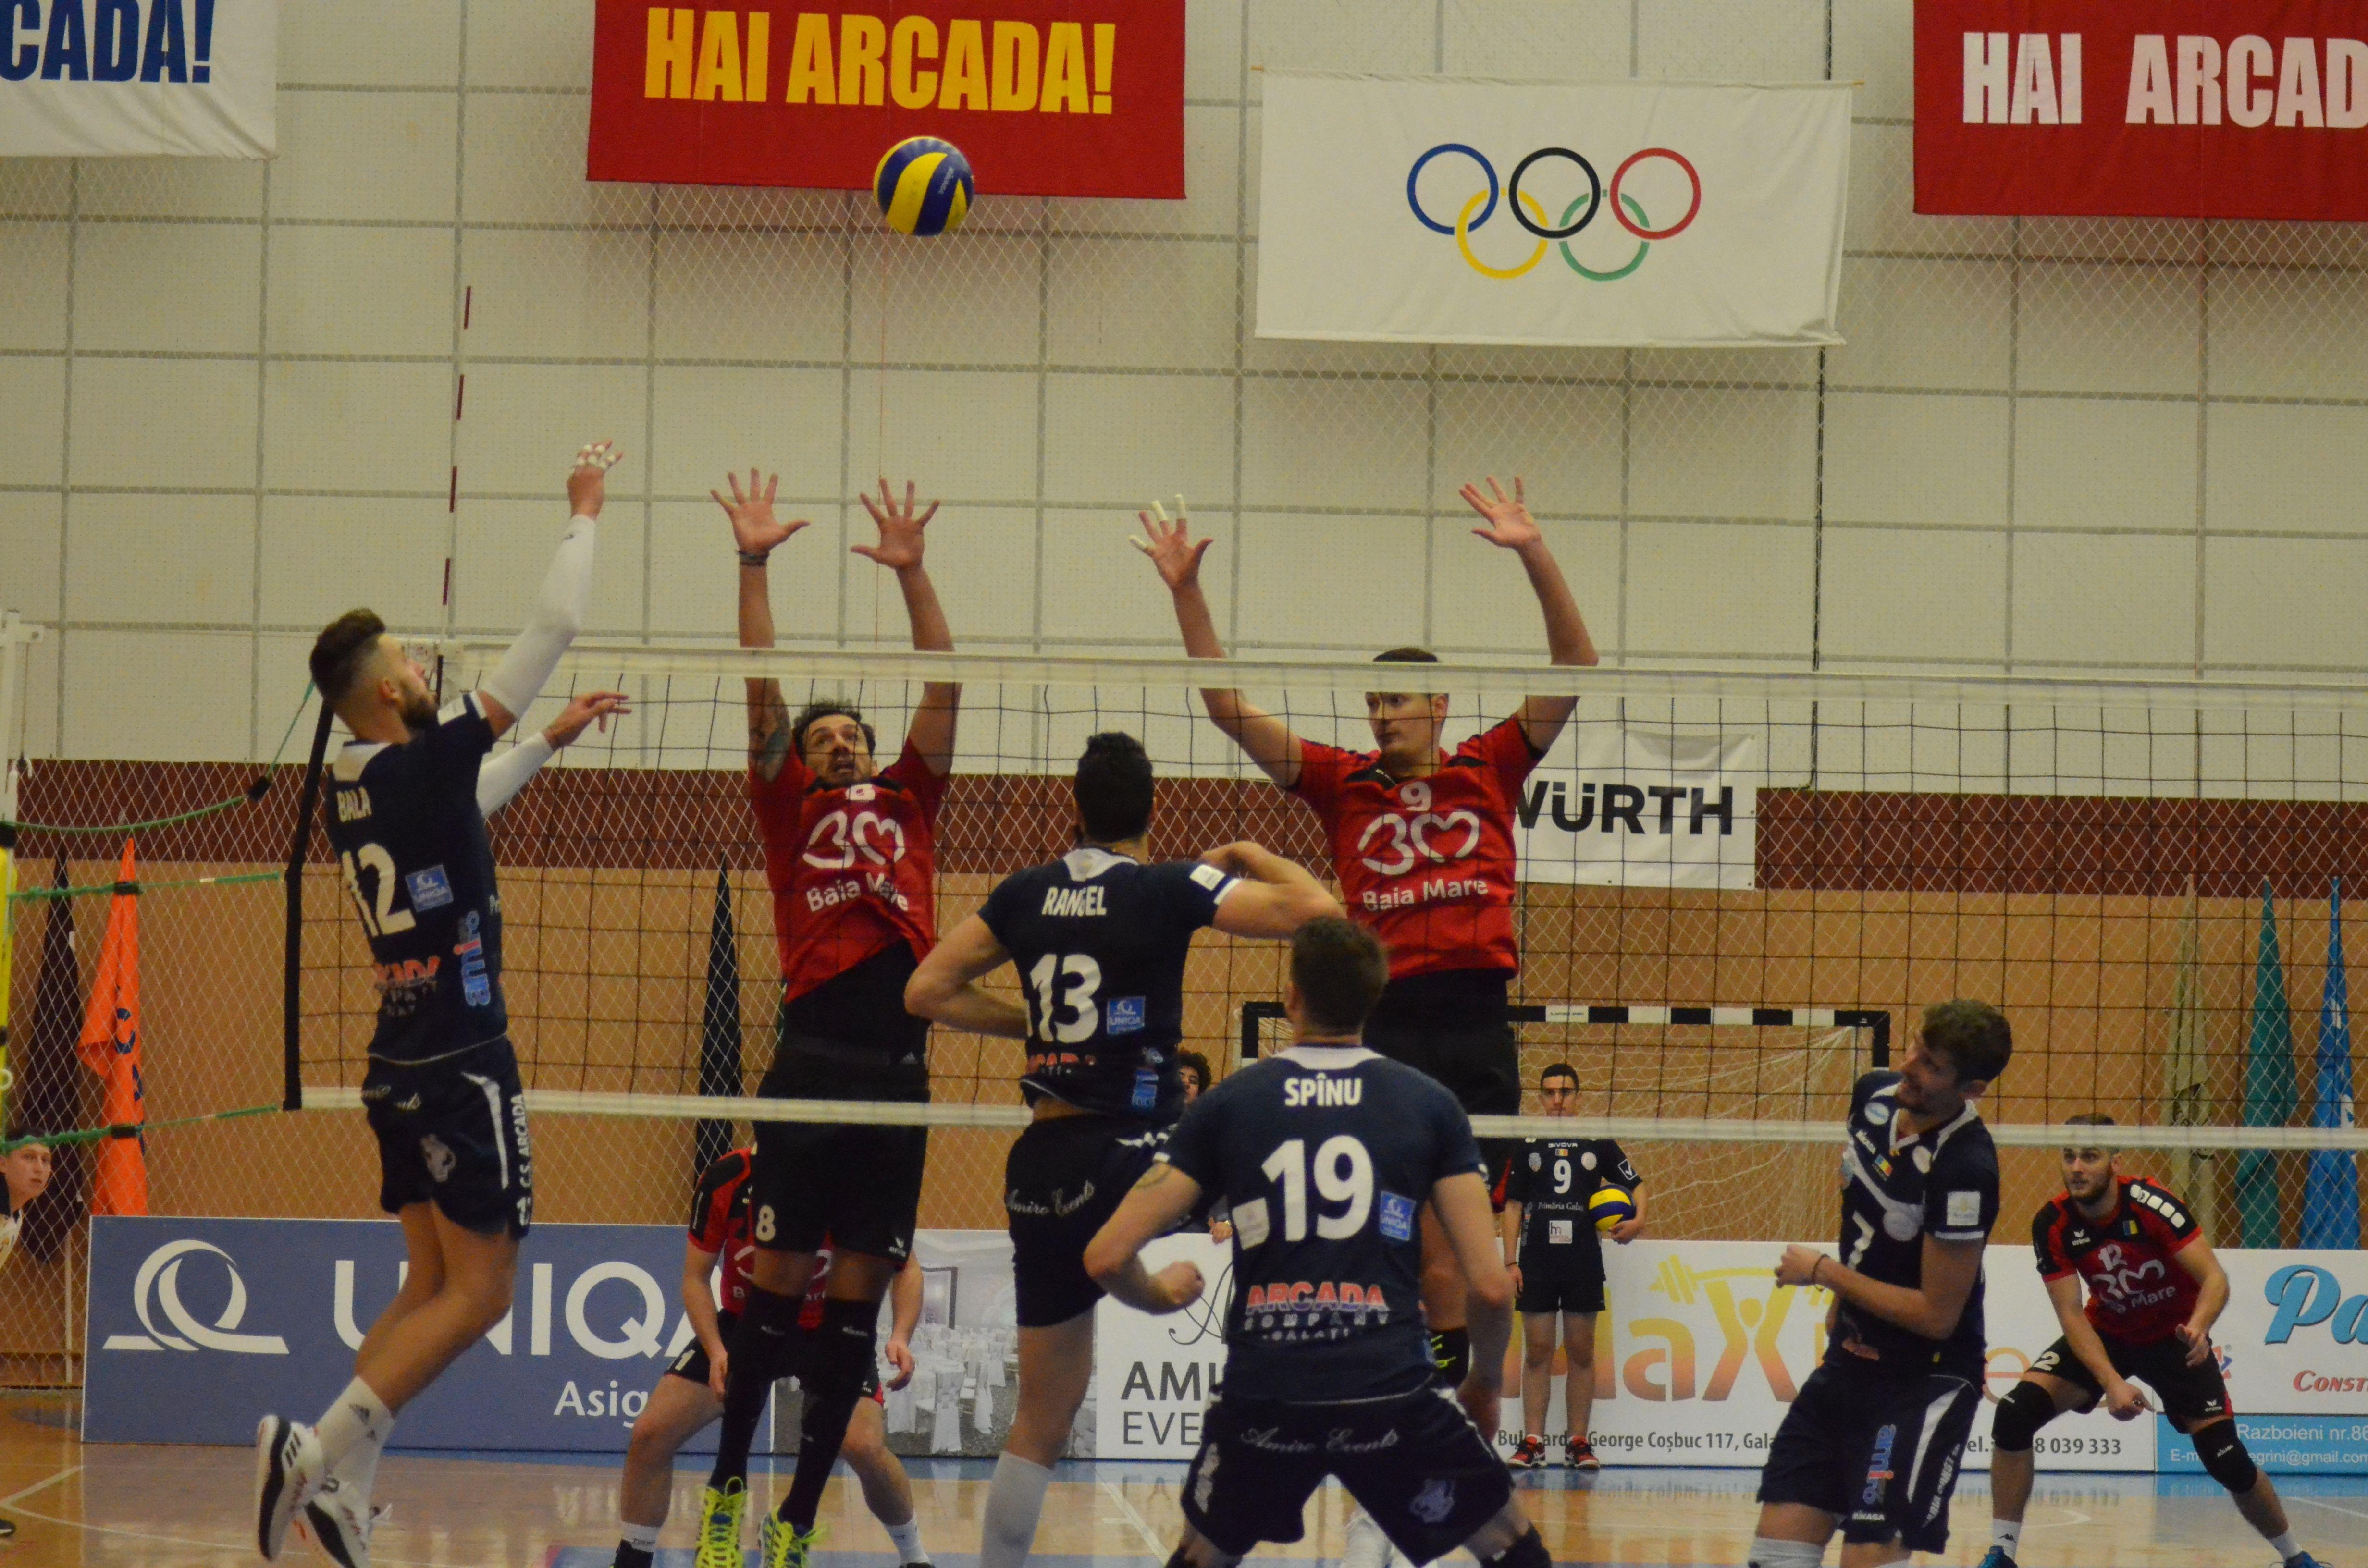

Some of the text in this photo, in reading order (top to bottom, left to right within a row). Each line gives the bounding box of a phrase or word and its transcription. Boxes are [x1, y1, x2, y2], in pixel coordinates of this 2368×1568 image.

[0, 0, 215, 84] CADA!
[644, 7, 1116, 115] HAI ARCADA!
[1963, 32, 2368, 128] HAI ARCAD
[1400, 782, 1431, 811] 9
[1362, 878, 1489, 912] Baia Mare
[1030, 954, 1102, 1044] 13
[1284, 1073, 1363, 1107] SPÎNU
[1261, 1135, 1375, 1242] 19
[1554, 1159, 1572, 1194] 9
[756, 1205, 776, 1242] 8
[1245, 1281, 1390, 1316] ARCADA
[2131, 1286, 2176, 1308] Mare
[2033, 1351, 2060, 1371] 2
[1498, 1430, 1567, 1446] Bulard
[1588, 1431, 1643, 1451] George
[1648, 1431, 1702, 1452] Coșbuc
[1706, 1433, 1739, 1451] 117,
[2049, 1438, 2084, 1454] 039
[2088, 1439, 2121, 1455] 333
[2237, 1423, 2323, 1440] Razboieni
[2171, 1448, 2368, 1466] E-m egrini@gmail.com
